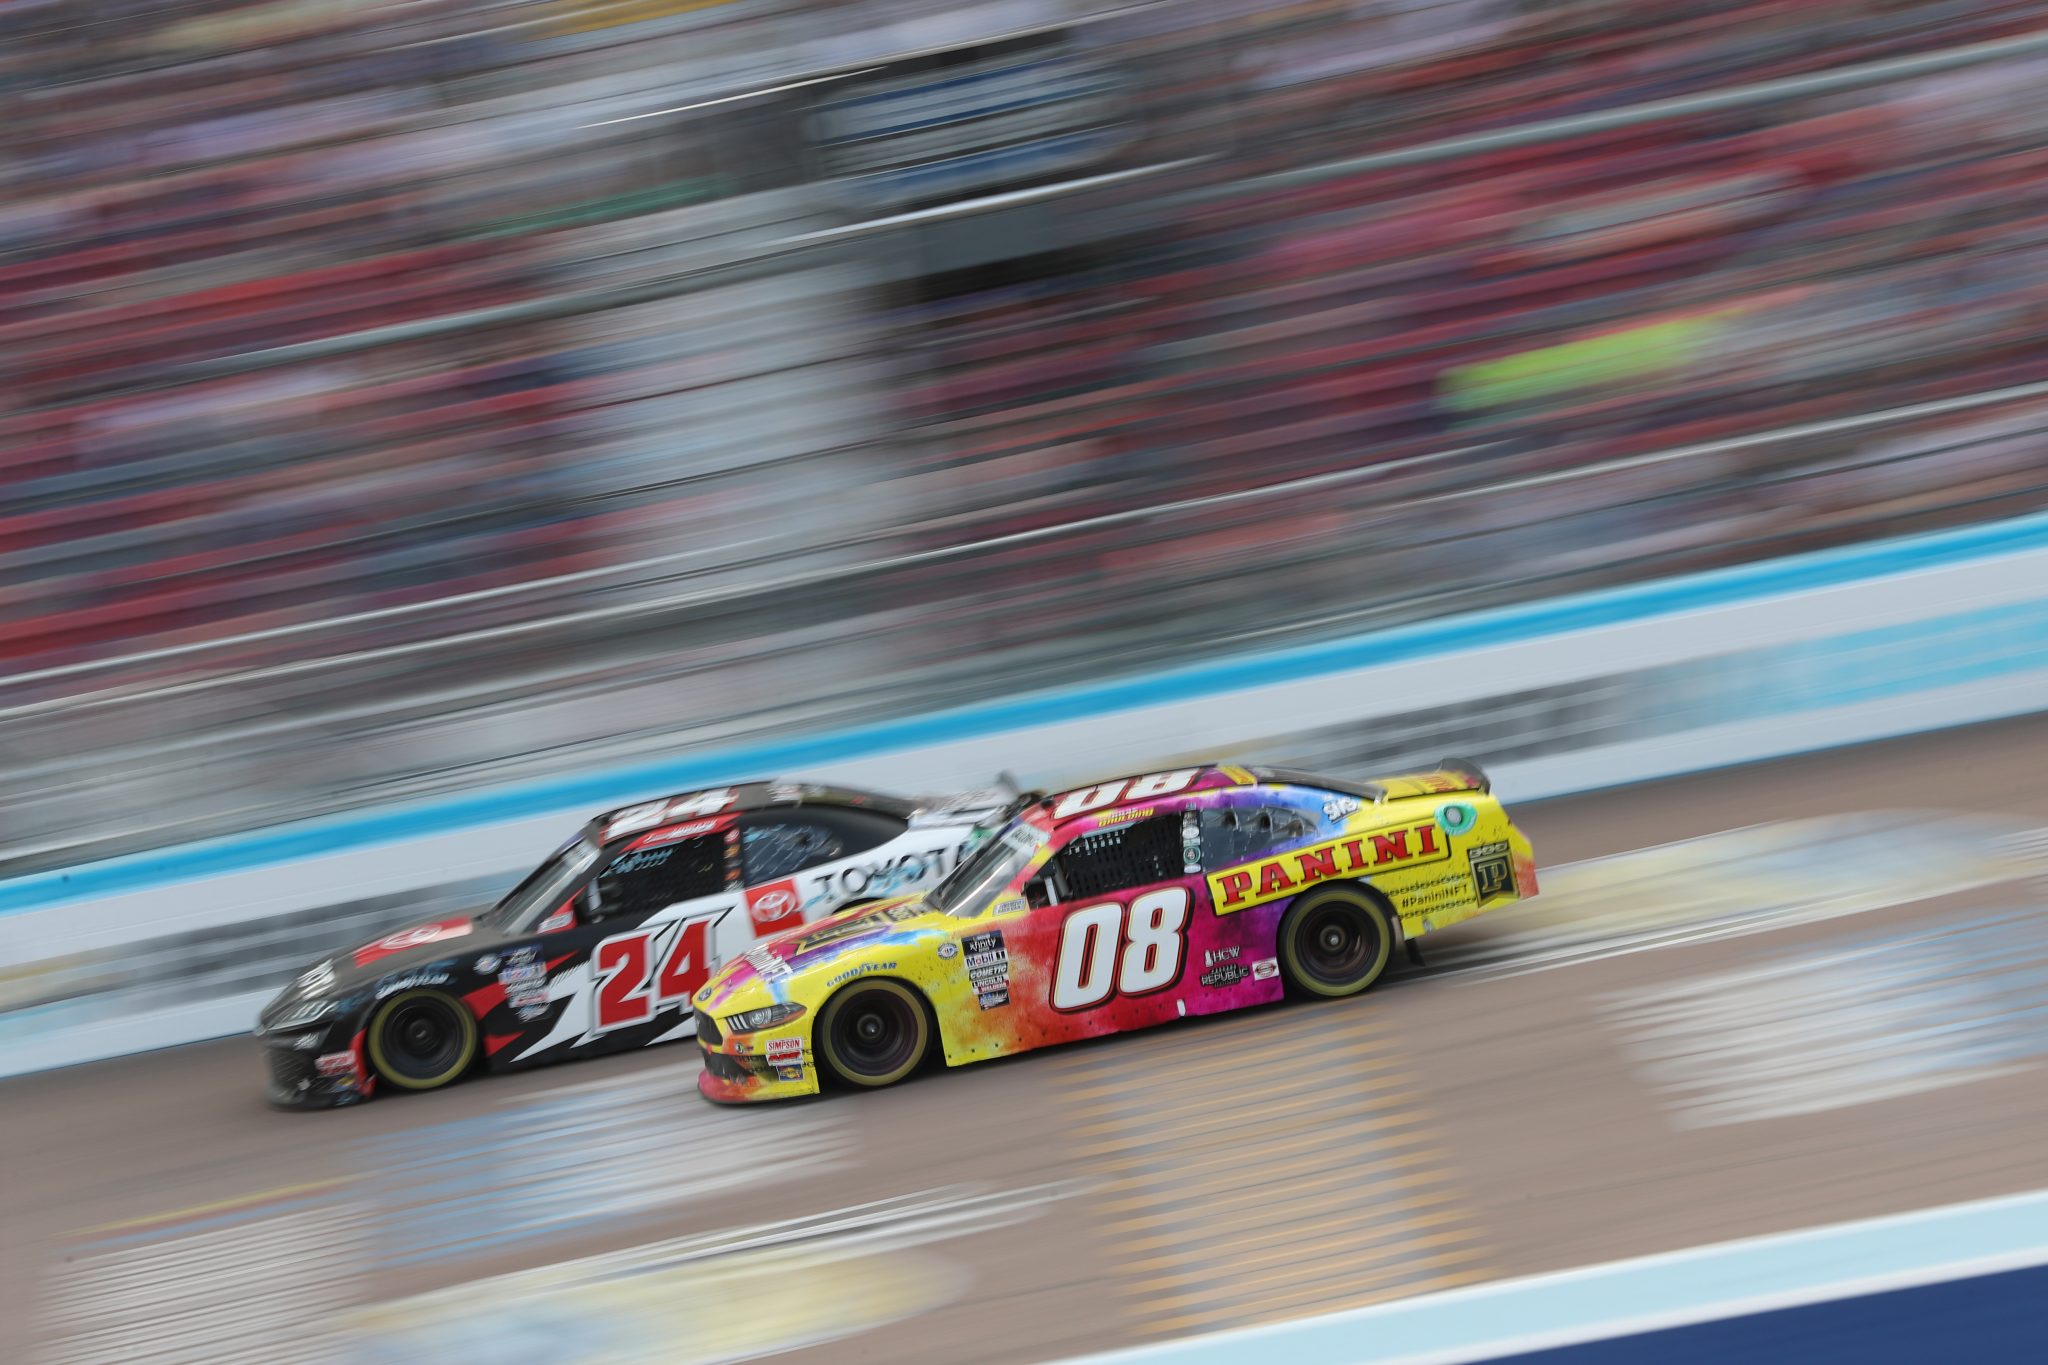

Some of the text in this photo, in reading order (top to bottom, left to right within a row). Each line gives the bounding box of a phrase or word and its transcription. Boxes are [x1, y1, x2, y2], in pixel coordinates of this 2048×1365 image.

[1053, 767, 1201, 820] 08
[1216, 823, 1441, 908] PANINI
[1401, 884, 1468, 908] #PaniniNFT
[966, 952, 994, 967] Mobil
[1050, 884, 1195, 1015] 08
[1212, 945, 1240, 963] HCW
[590, 915, 718, 1037] 24
[827, 962, 897, 987] GOODYEAR
[970, 964, 1007, 980] COMETIC
[972, 975, 1004, 988] LINCOLN
[1201, 967, 1249, 987] REPUBLIC
[768, 1039, 801, 1051] SIMPSON
